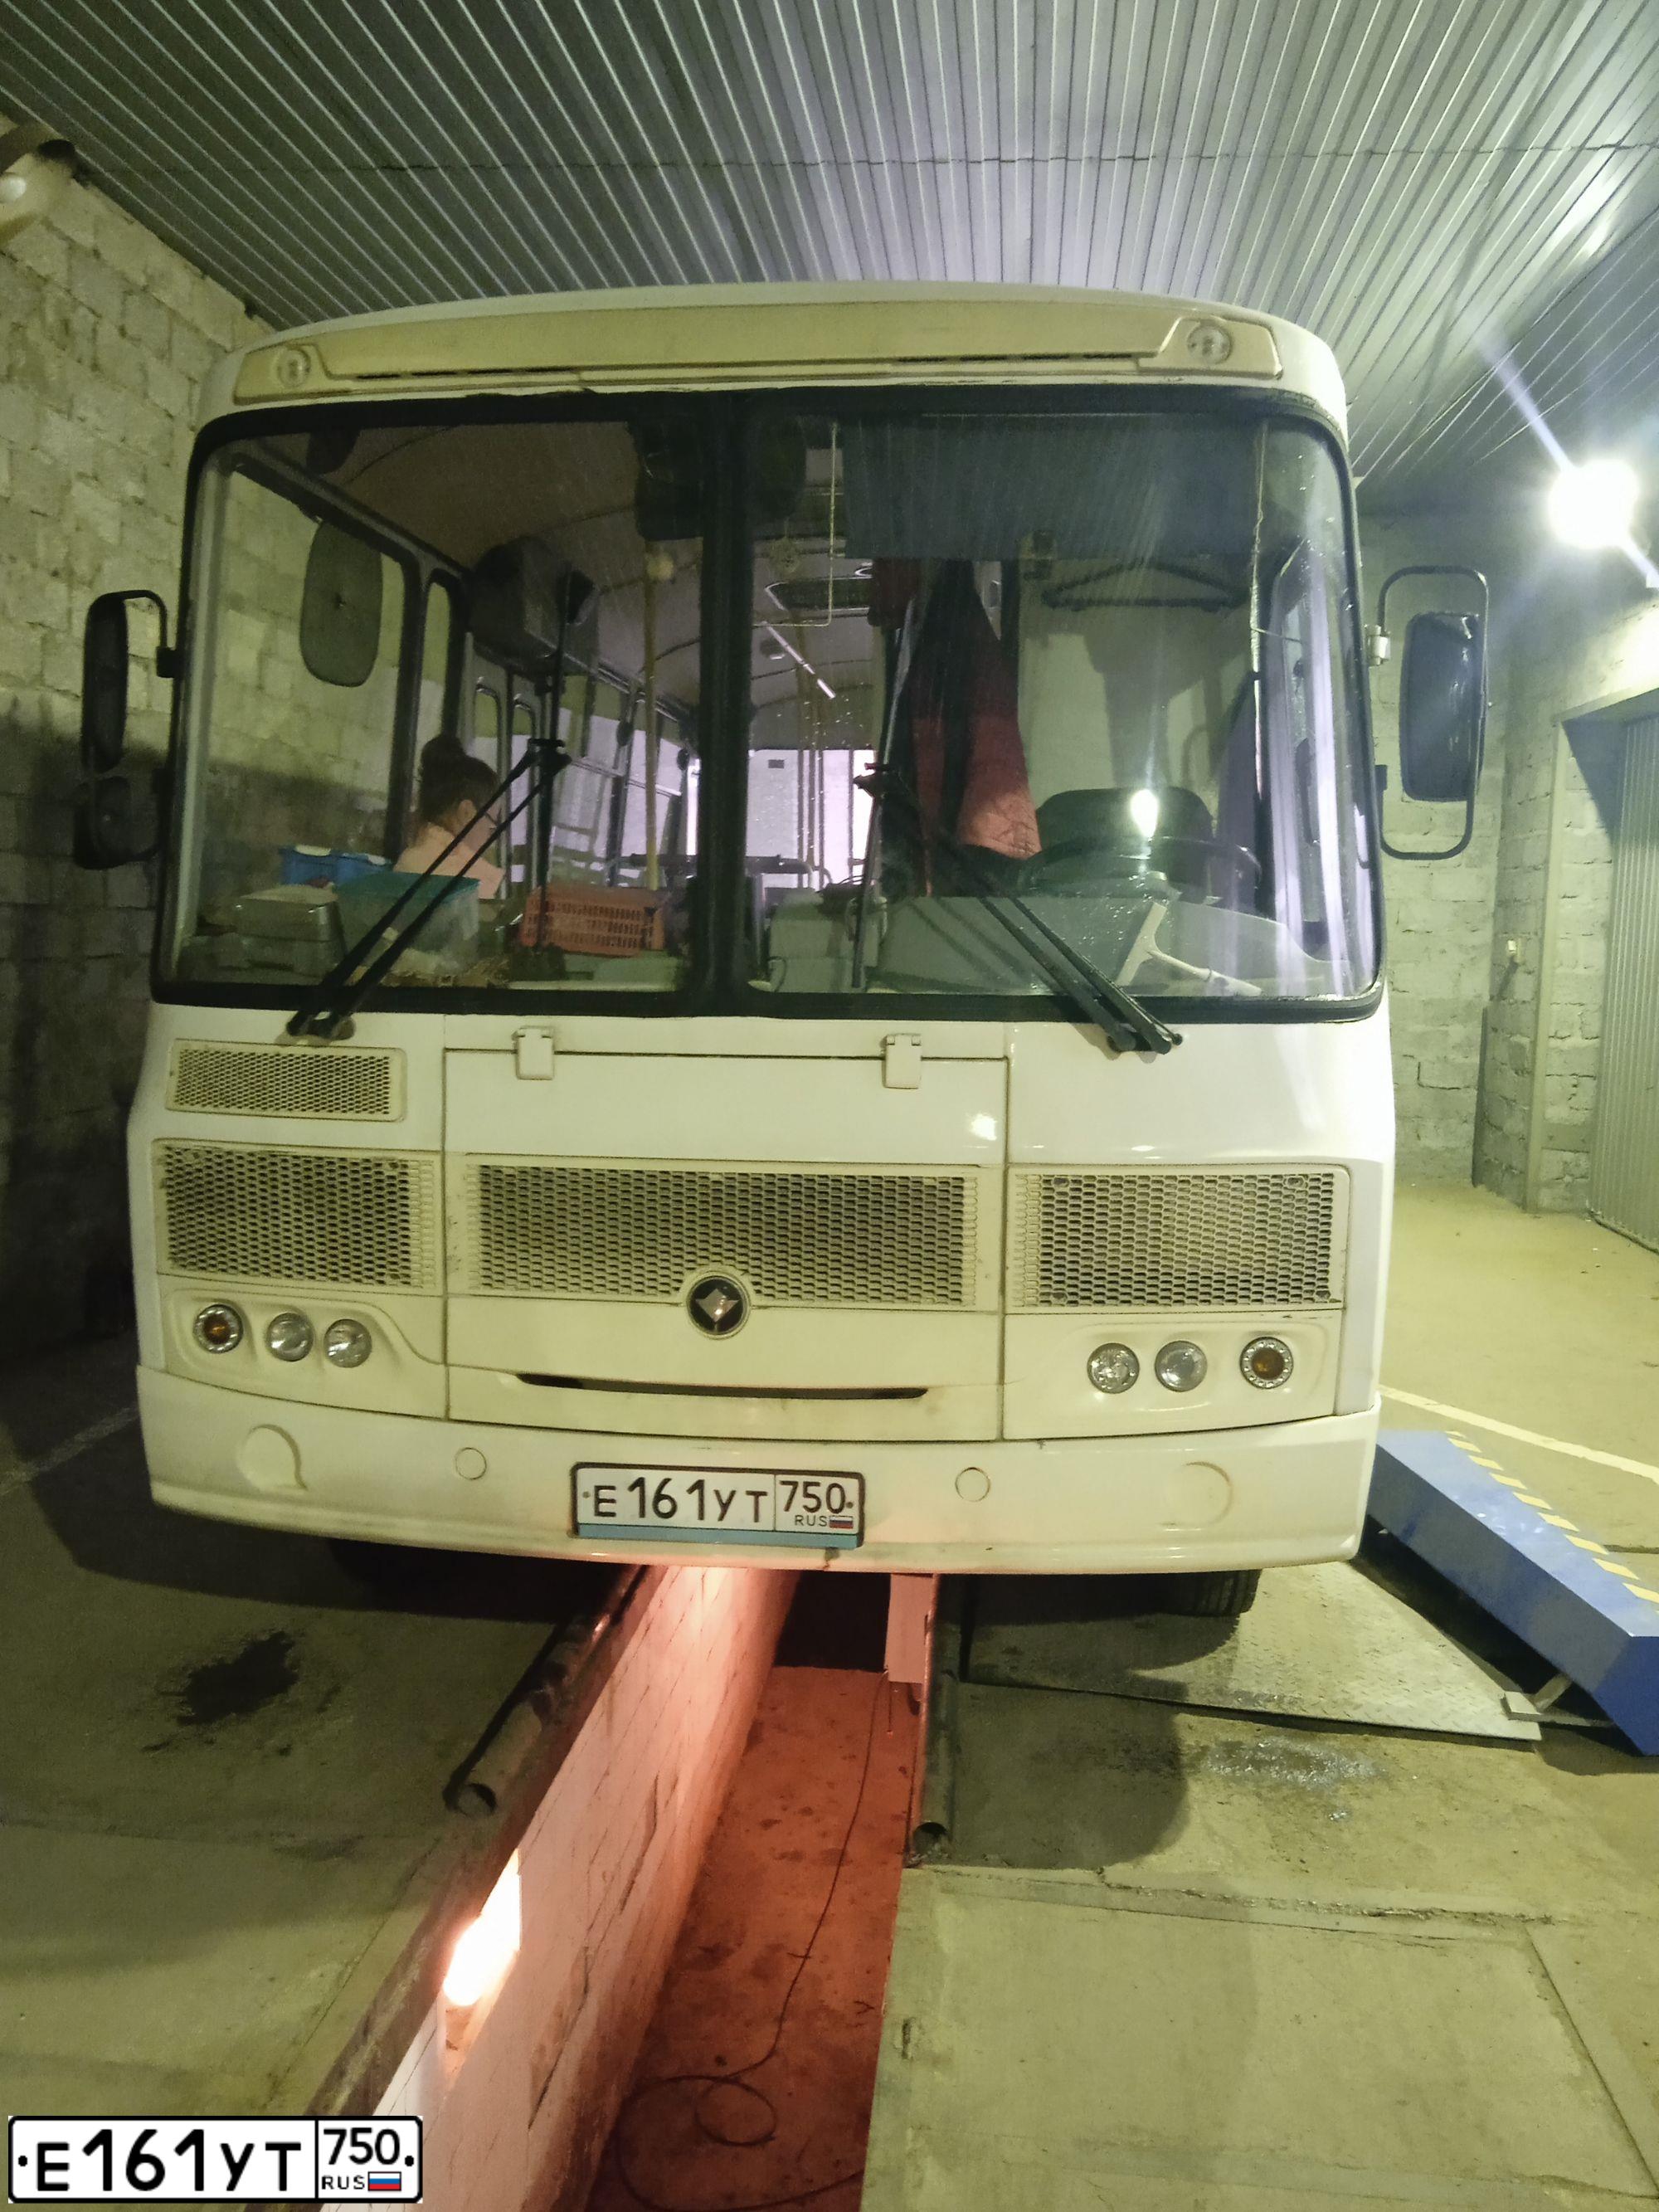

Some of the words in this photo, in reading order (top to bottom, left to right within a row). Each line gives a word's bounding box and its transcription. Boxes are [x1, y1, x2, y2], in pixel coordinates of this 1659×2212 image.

[593, 1476, 768, 1523] Е161УТ
[778, 1479, 846, 1515] 750
[794, 1514, 828, 1527] RUS
